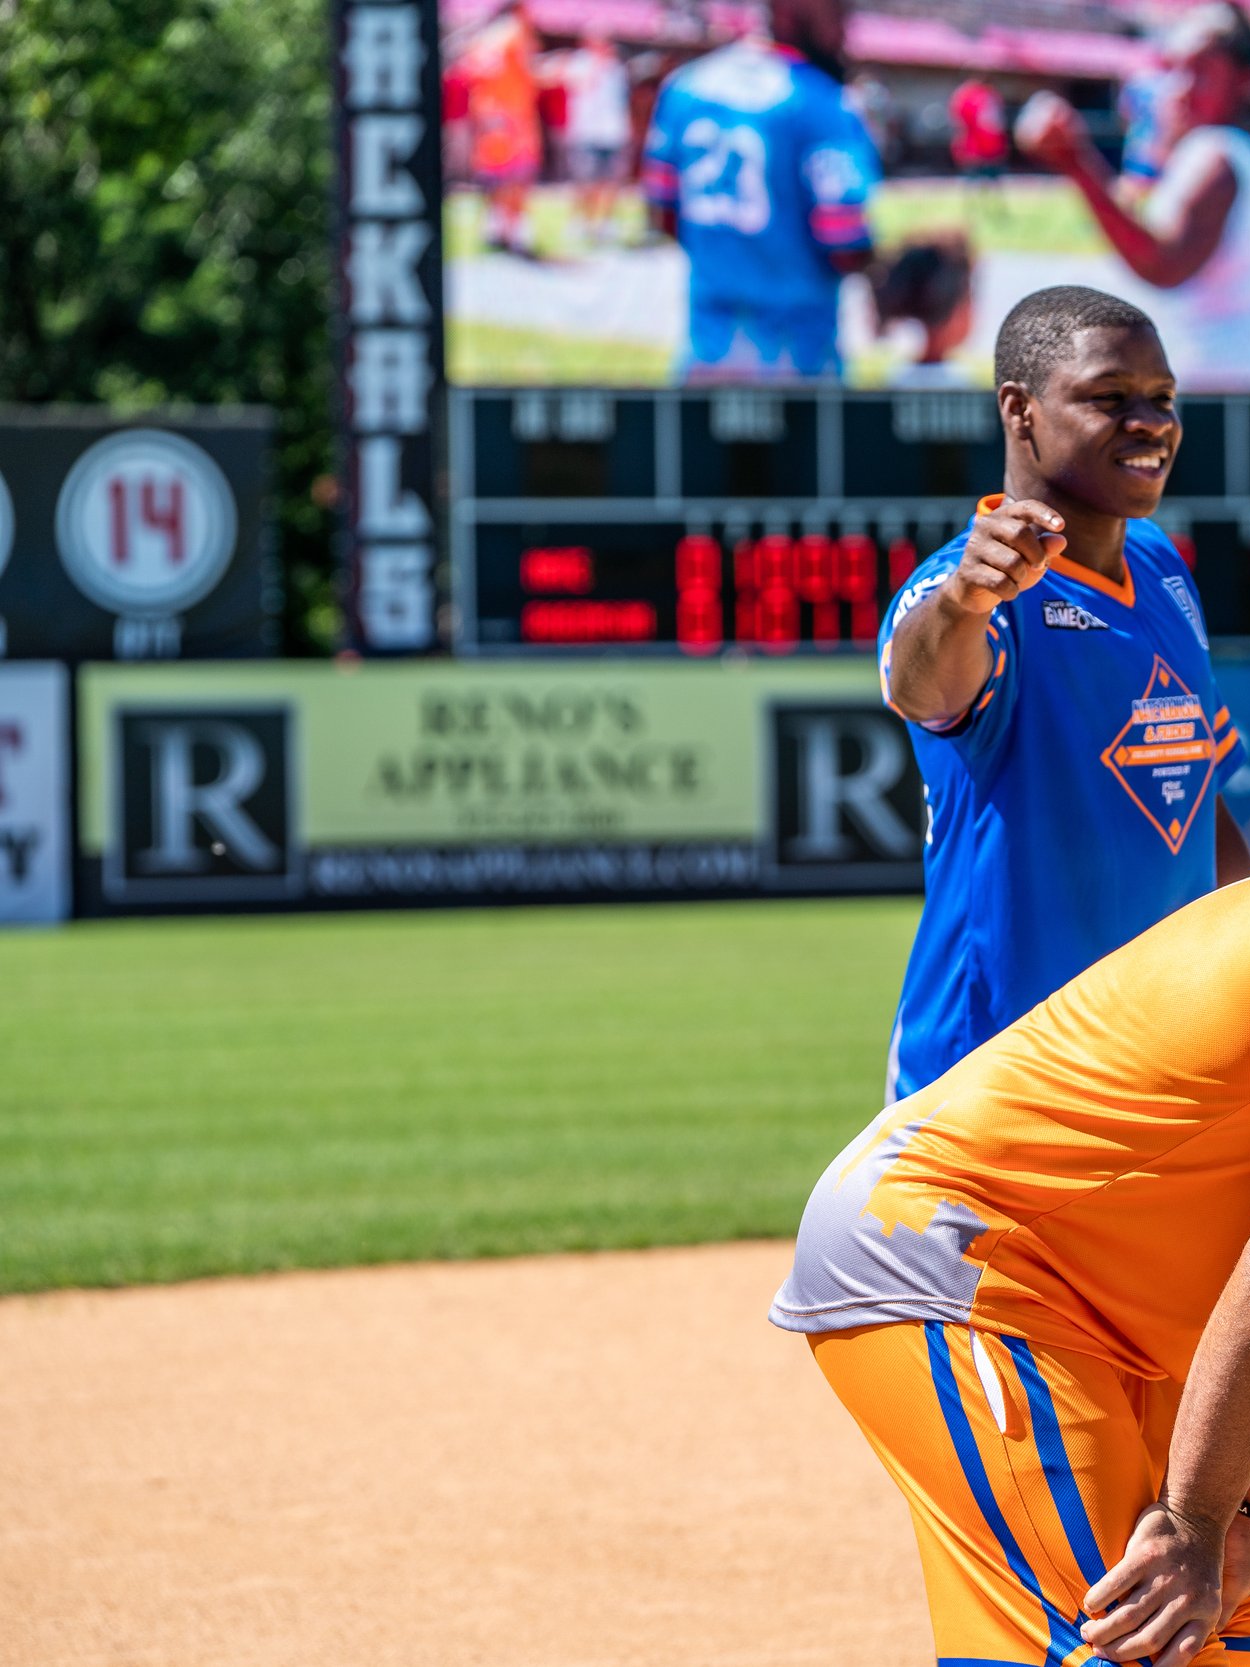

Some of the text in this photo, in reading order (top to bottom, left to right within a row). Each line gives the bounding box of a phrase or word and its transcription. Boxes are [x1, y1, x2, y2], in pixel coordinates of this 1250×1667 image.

[108, 476, 185, 564] 14
[140, 718, 278, 873] R
[367, 742, 712, 798] APPLIANCE
[786, 718, 916, 862] R
